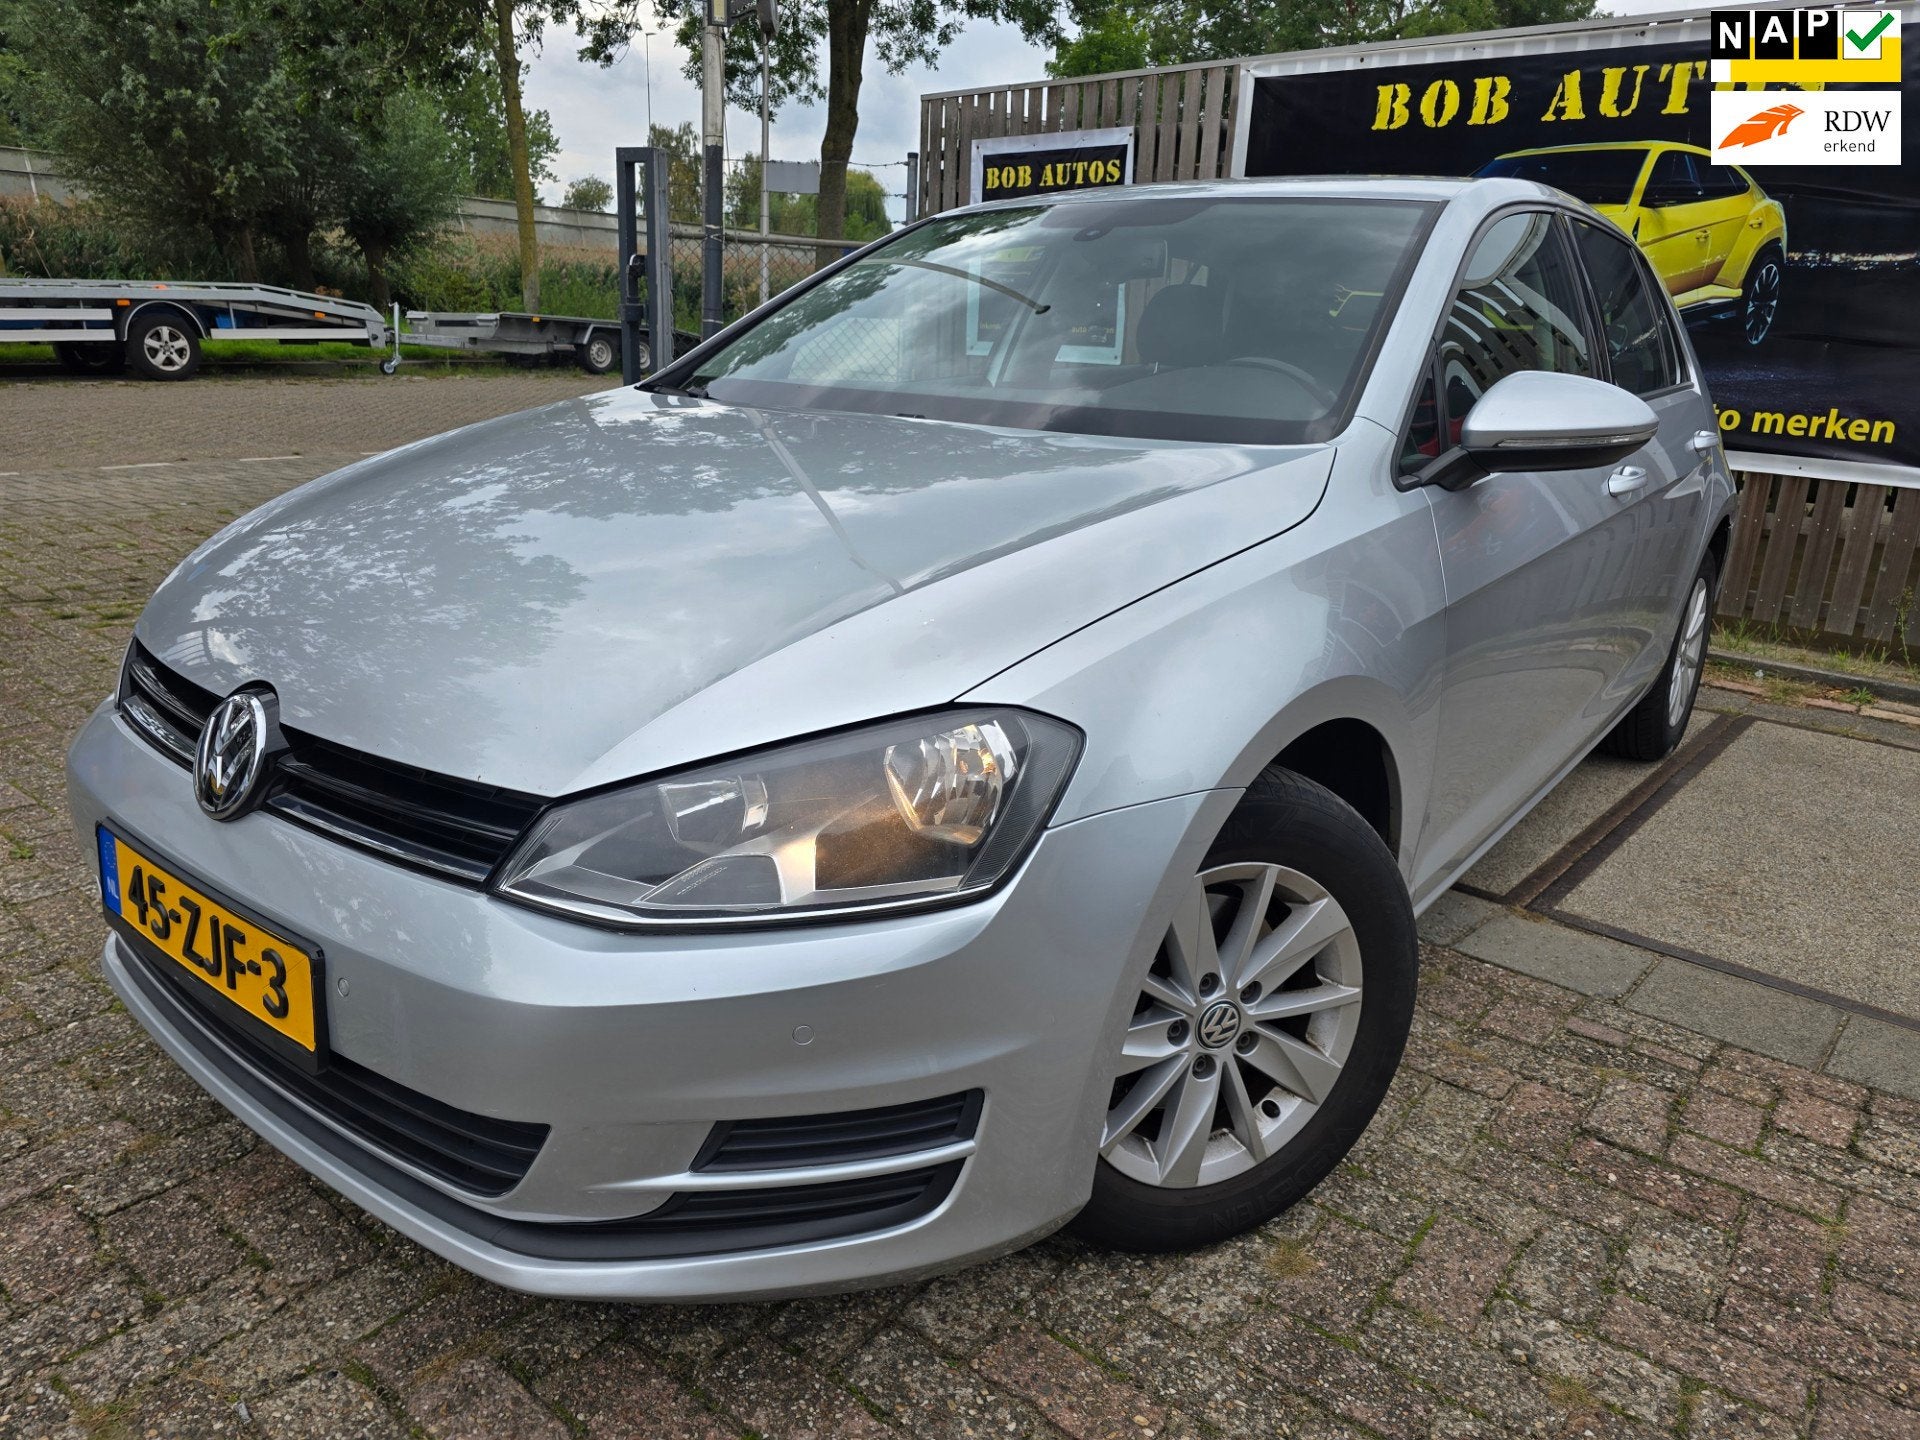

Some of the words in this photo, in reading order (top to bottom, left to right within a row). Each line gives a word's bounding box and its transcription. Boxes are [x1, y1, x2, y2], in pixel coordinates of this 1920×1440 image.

[1371, 76, 1512, 131] BOB
[1541, 60, 1826, 122] AUT
[986, 165, 1032, 189] BOB
[1039, 159, 1121, 186] AUTOS
[1751, 408, 1896, 444] merken
[107, 876, 119, 899] NL
[128, 864, 290, 1019] 45-ZJF-3
